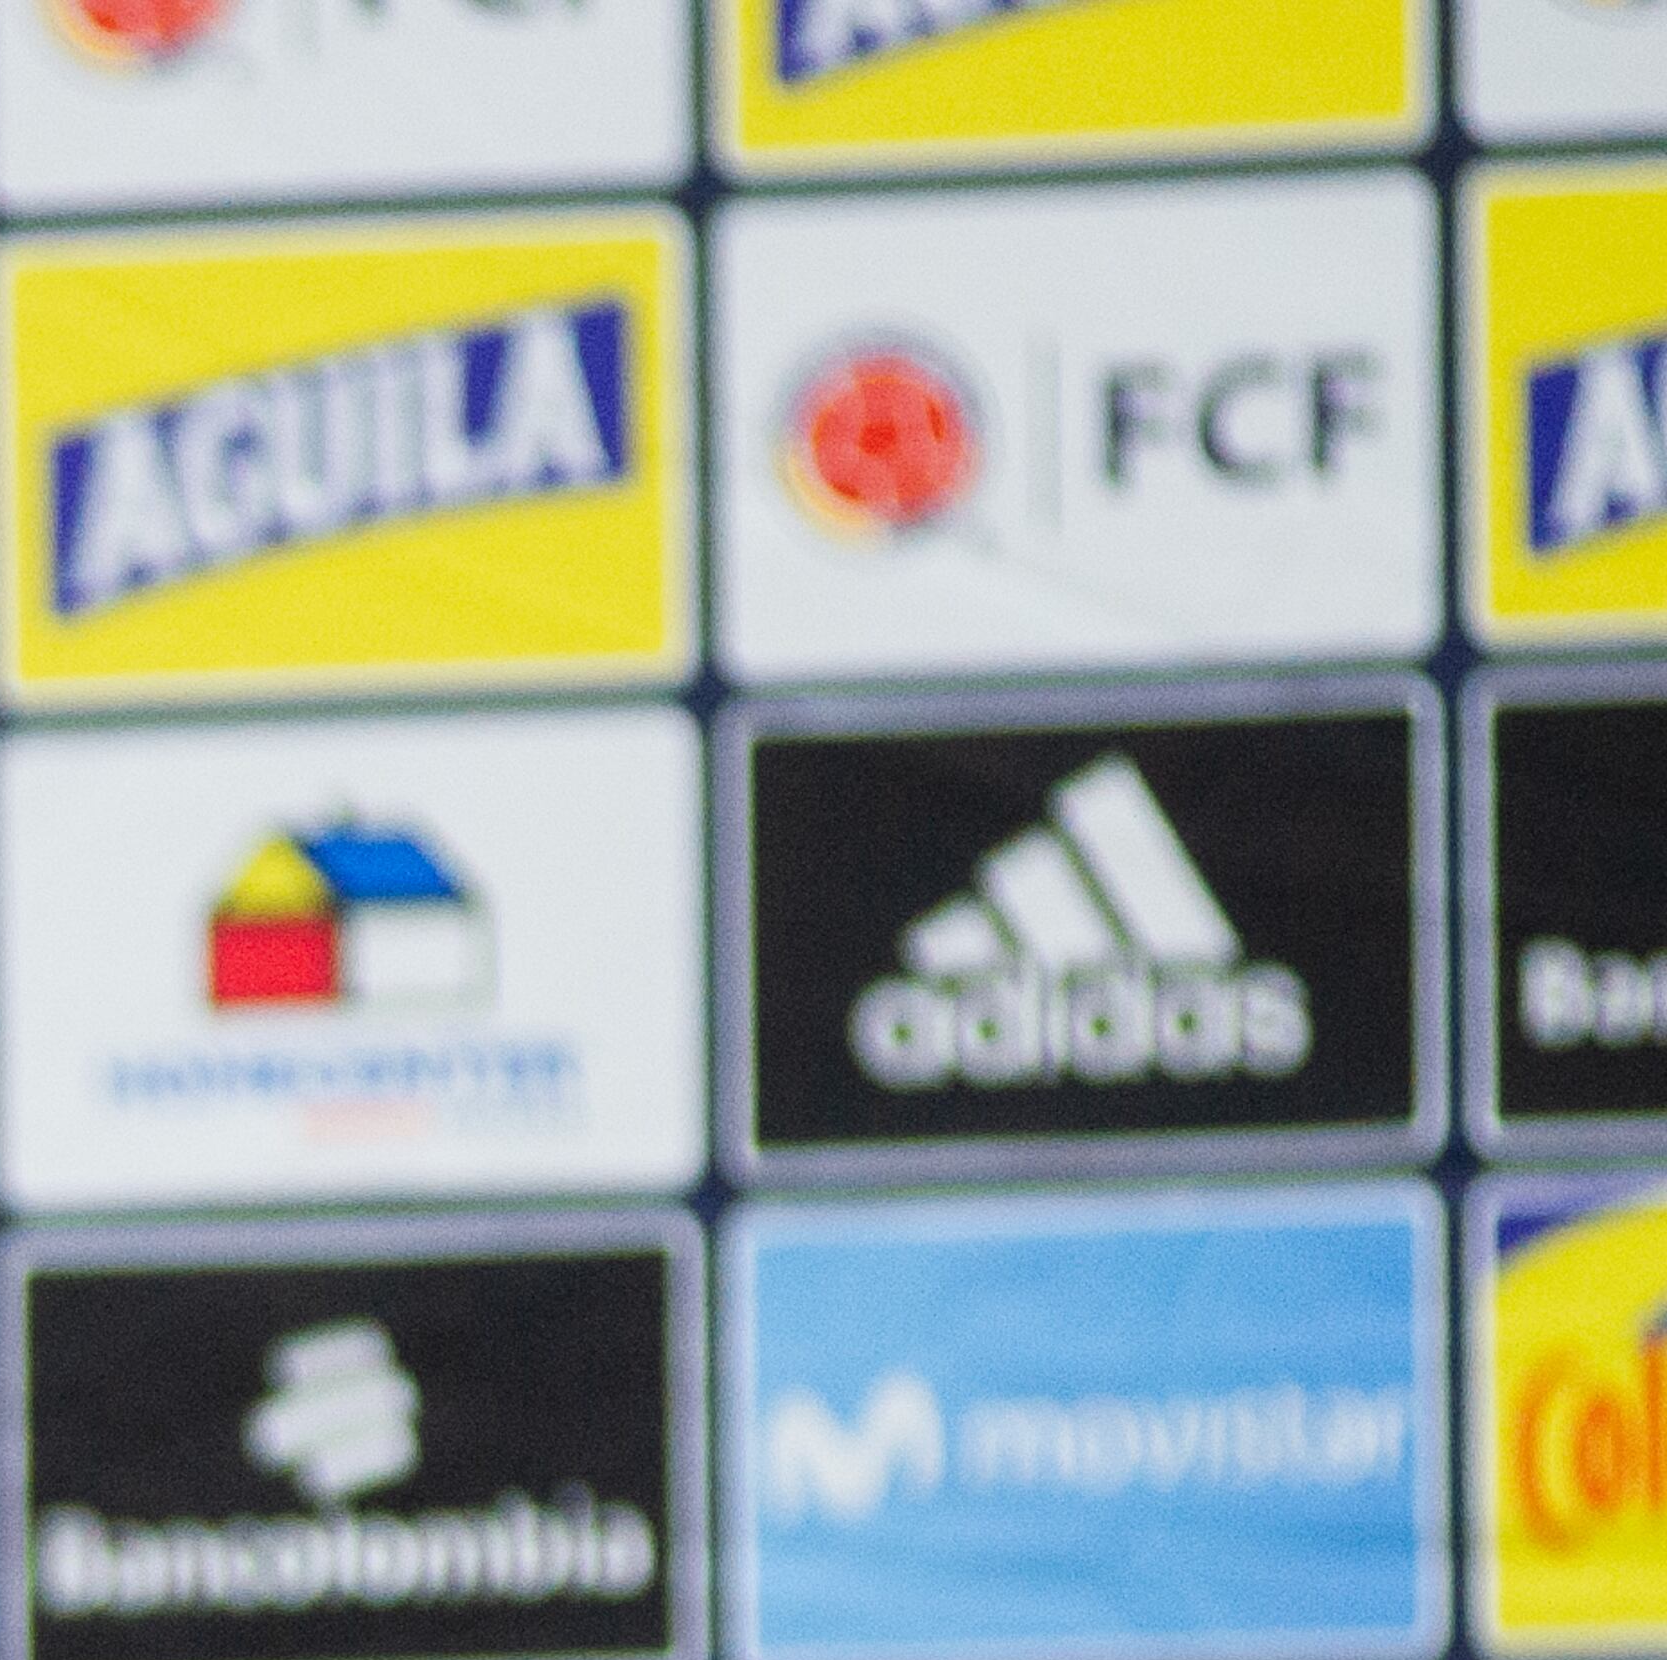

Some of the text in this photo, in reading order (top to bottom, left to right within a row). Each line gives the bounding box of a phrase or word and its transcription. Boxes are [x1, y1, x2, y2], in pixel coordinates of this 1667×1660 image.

[63, 306, 619, 606] AGUILA
[1099, 352, 1385, 488] FCF
[852, 962, 1312, 1086] adidas
[957, 1382, 1409, 1496] movistar
[39, 1486, 657, 1614] Bancolombia
